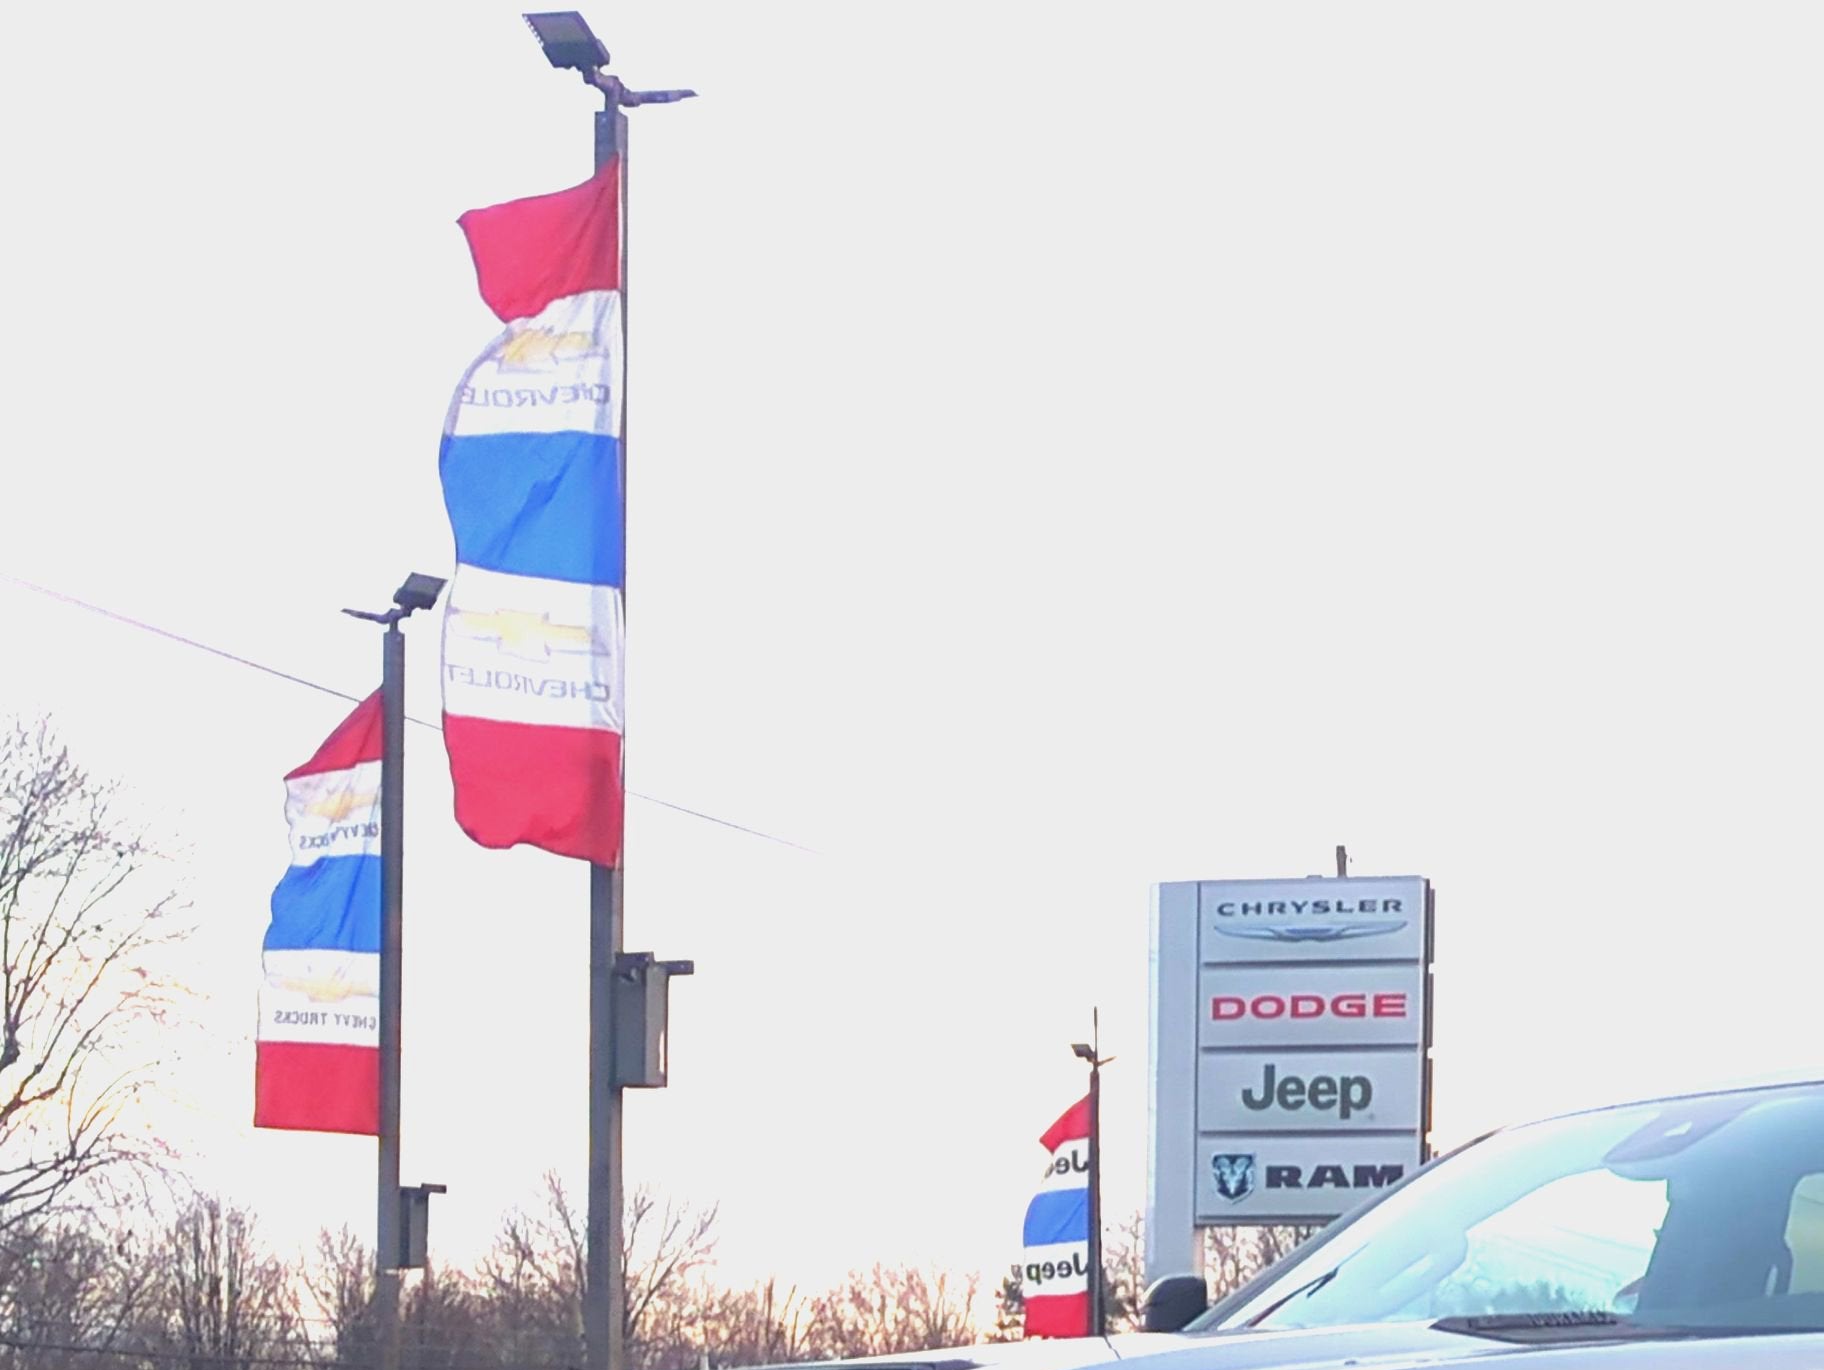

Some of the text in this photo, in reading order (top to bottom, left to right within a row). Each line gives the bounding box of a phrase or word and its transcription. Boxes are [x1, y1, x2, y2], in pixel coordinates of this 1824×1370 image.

[1217, 899, 1403, 917] CHRYSLER
[1212, 993, 1407, 1021] DODGE
[1242, 1063, 1373, 1120] Jeep
[1266, 1164, 1404, 1190] RAM
